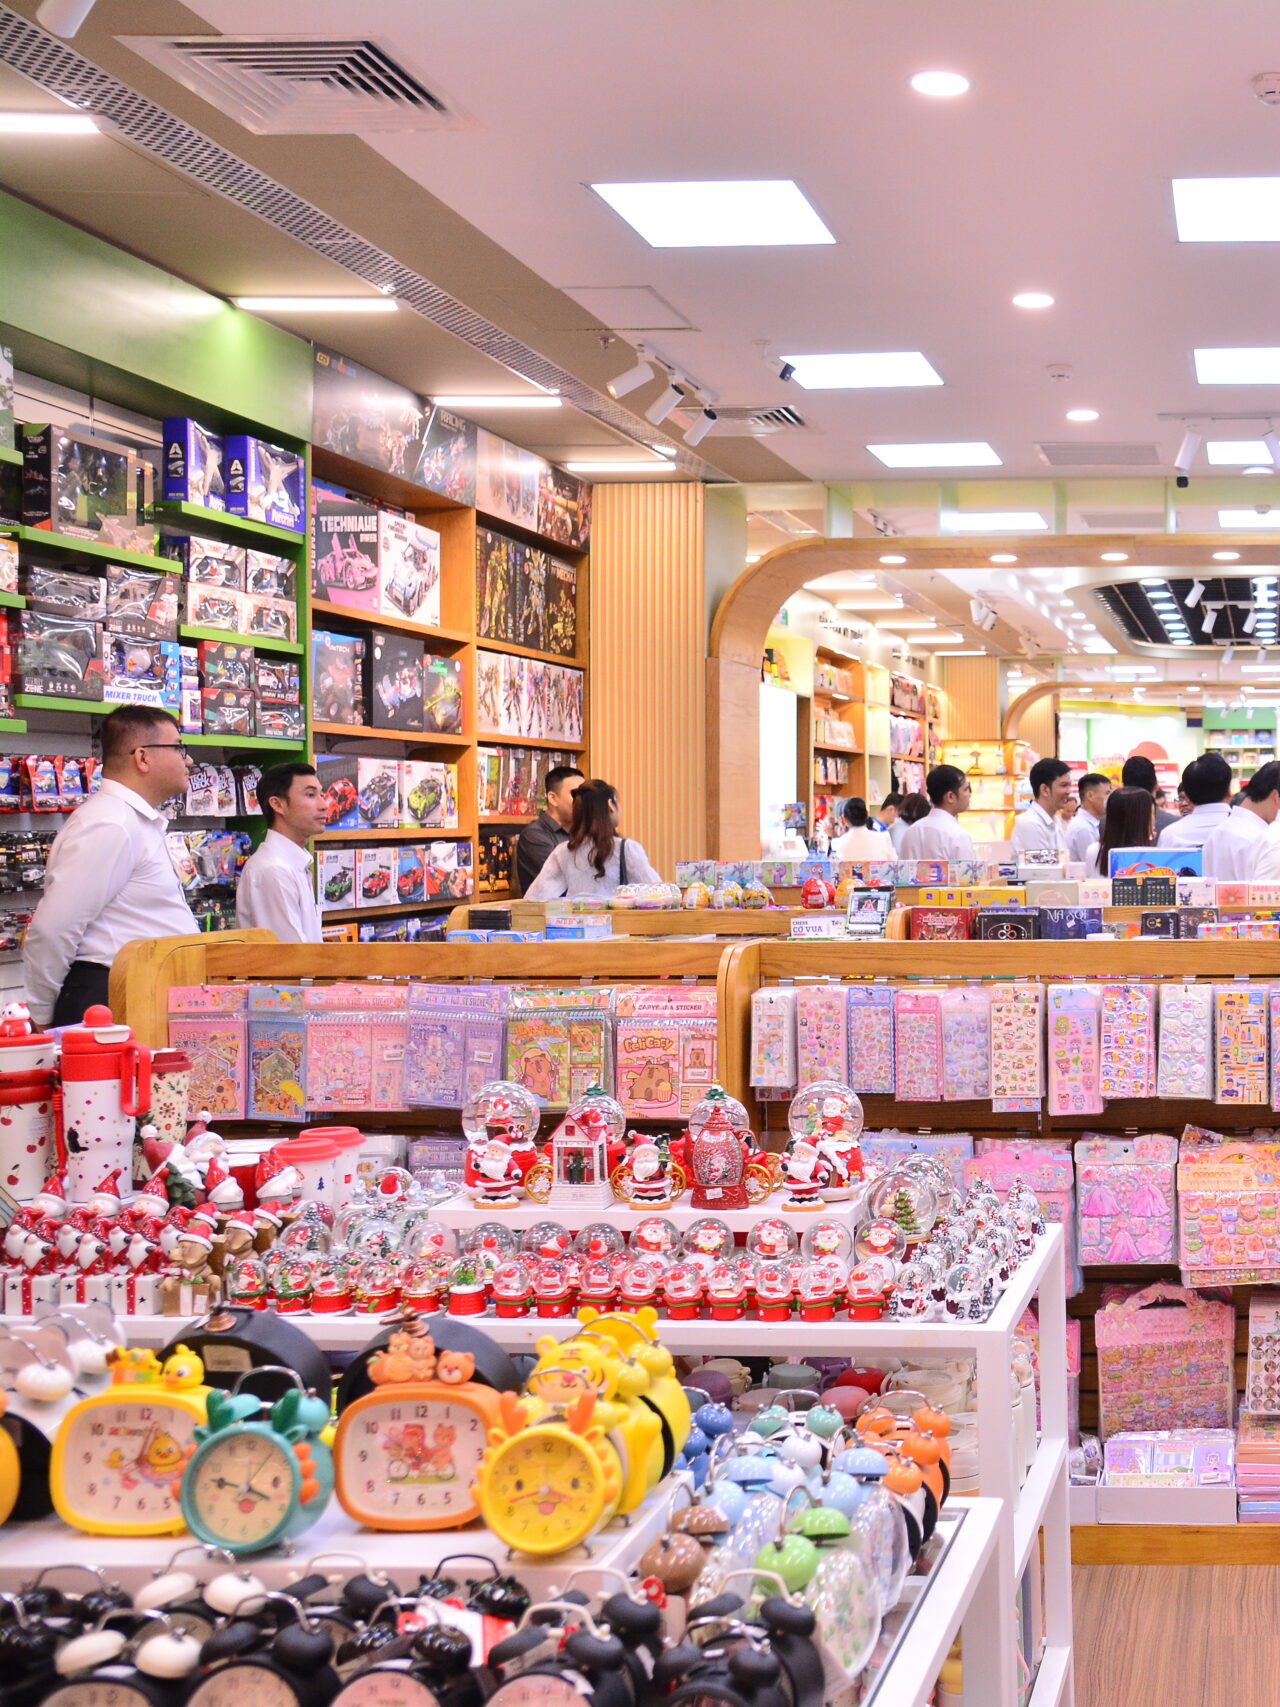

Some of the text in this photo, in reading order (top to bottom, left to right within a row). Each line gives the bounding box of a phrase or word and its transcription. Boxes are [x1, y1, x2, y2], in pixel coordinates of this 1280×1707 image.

[105, 690, 157, 702] MIXER TRUCK
[189, 770, 207, 785] TECH
[191, 780, 211, 792] DECK
[805, 925, 823, 933] VUA
[116, 1410, 127, 1423] 11
[140, 1408, 152, 1421] 12
[169, 1409, 174, 1422] 1
[391, 1408, 401, 1420] 11
[415, 1405, 428, 1418] 12
[446, 1407, 450, 1419] 1
[91, 1423, 104, 1436] 10
[366, 1422, 378, 1434] 10
[470, 1419, 478, 1431] 2
[83, 1452, 92, 1464] 9
[359, 1450, 368, 1462] 9
[476, 1448, 484, 1461] 3
[88, 1483, 97, 1496] 8
[366, 1480, 375, 1493] 8
[113, 1496, 121, 1510] 7
[137, 1498, 145, 1510] 6
[164, 1497, 171, 1510] 5
[392, 1492, 401, 1505] 7
[417, 1493, 426, 1505] 6
[444, 1492, 452, 1504] 5
